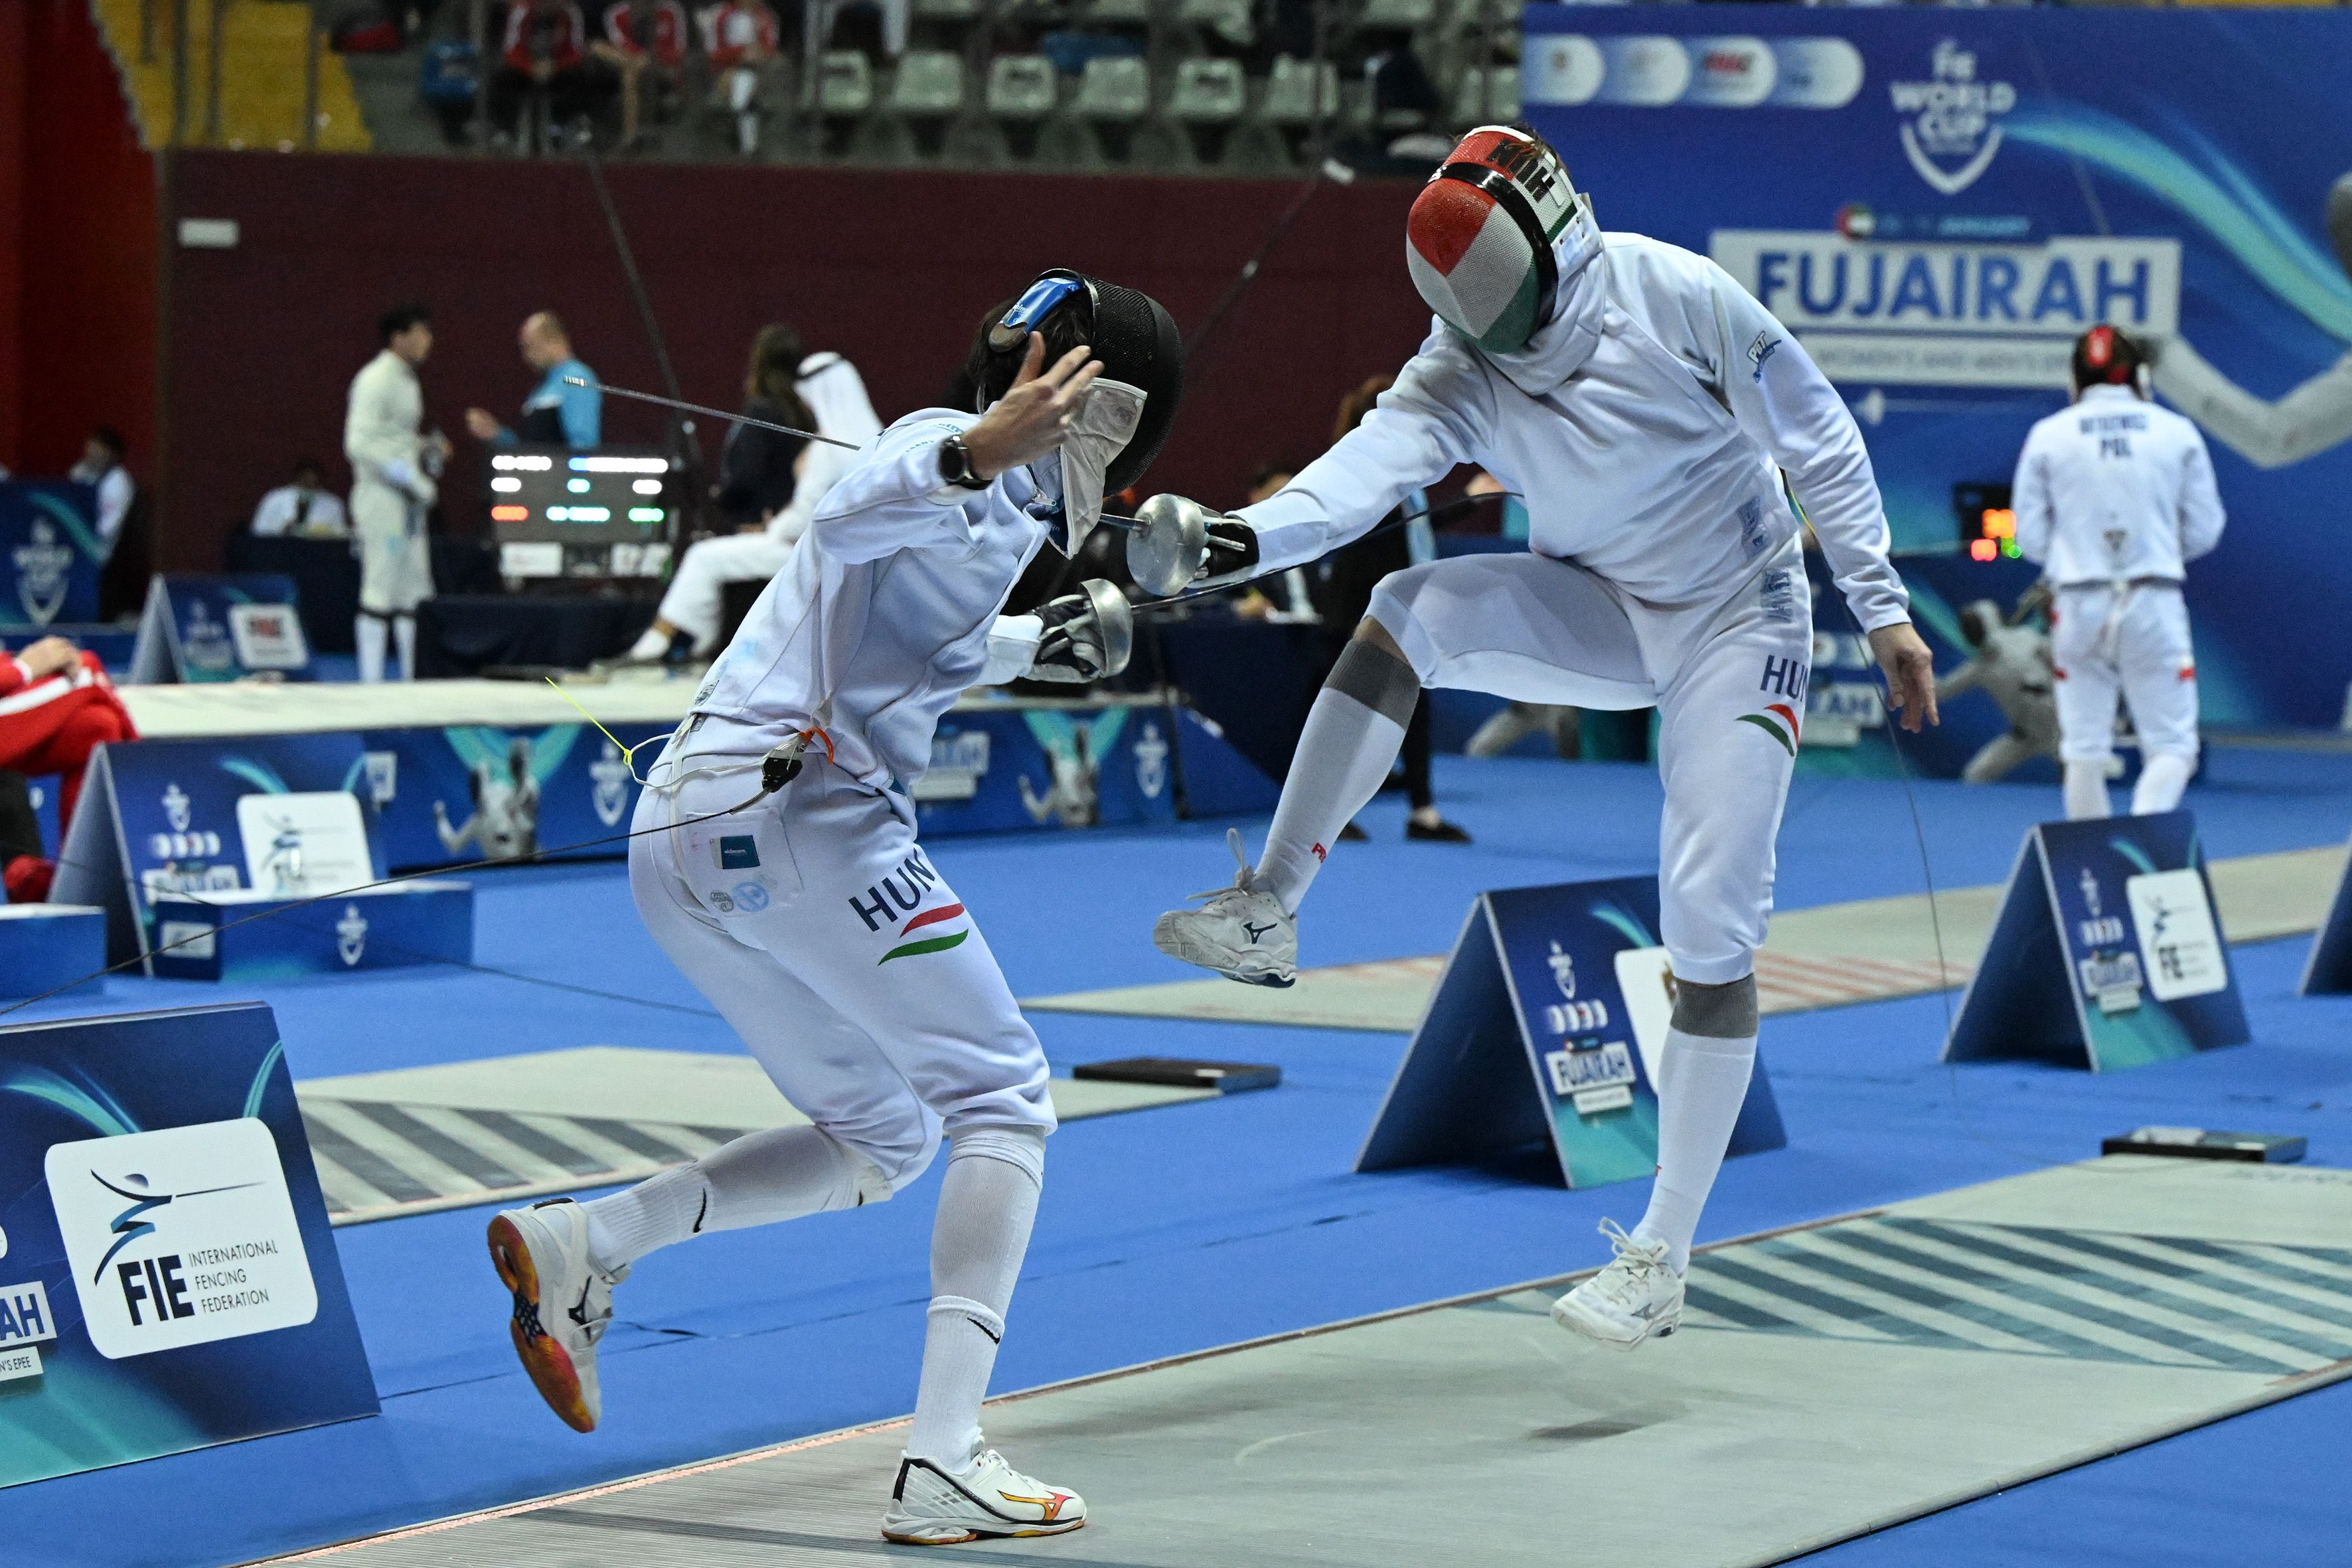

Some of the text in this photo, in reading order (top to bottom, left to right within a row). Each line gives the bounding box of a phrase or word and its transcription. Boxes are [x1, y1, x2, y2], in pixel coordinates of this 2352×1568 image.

[1758, 252, 2148, 323] FUJAIRAH
[848, 848, 935, 932] HUN
[189, 1240, 278, 1267] INTERNATIONAL
[118, 1255, 195, 1326] FIE
[195, 1269, 246, 1290] FENCING
[201, 1289, 270, 1313] FEDERATION
[13, 1356, 31, 1370] EPEE
